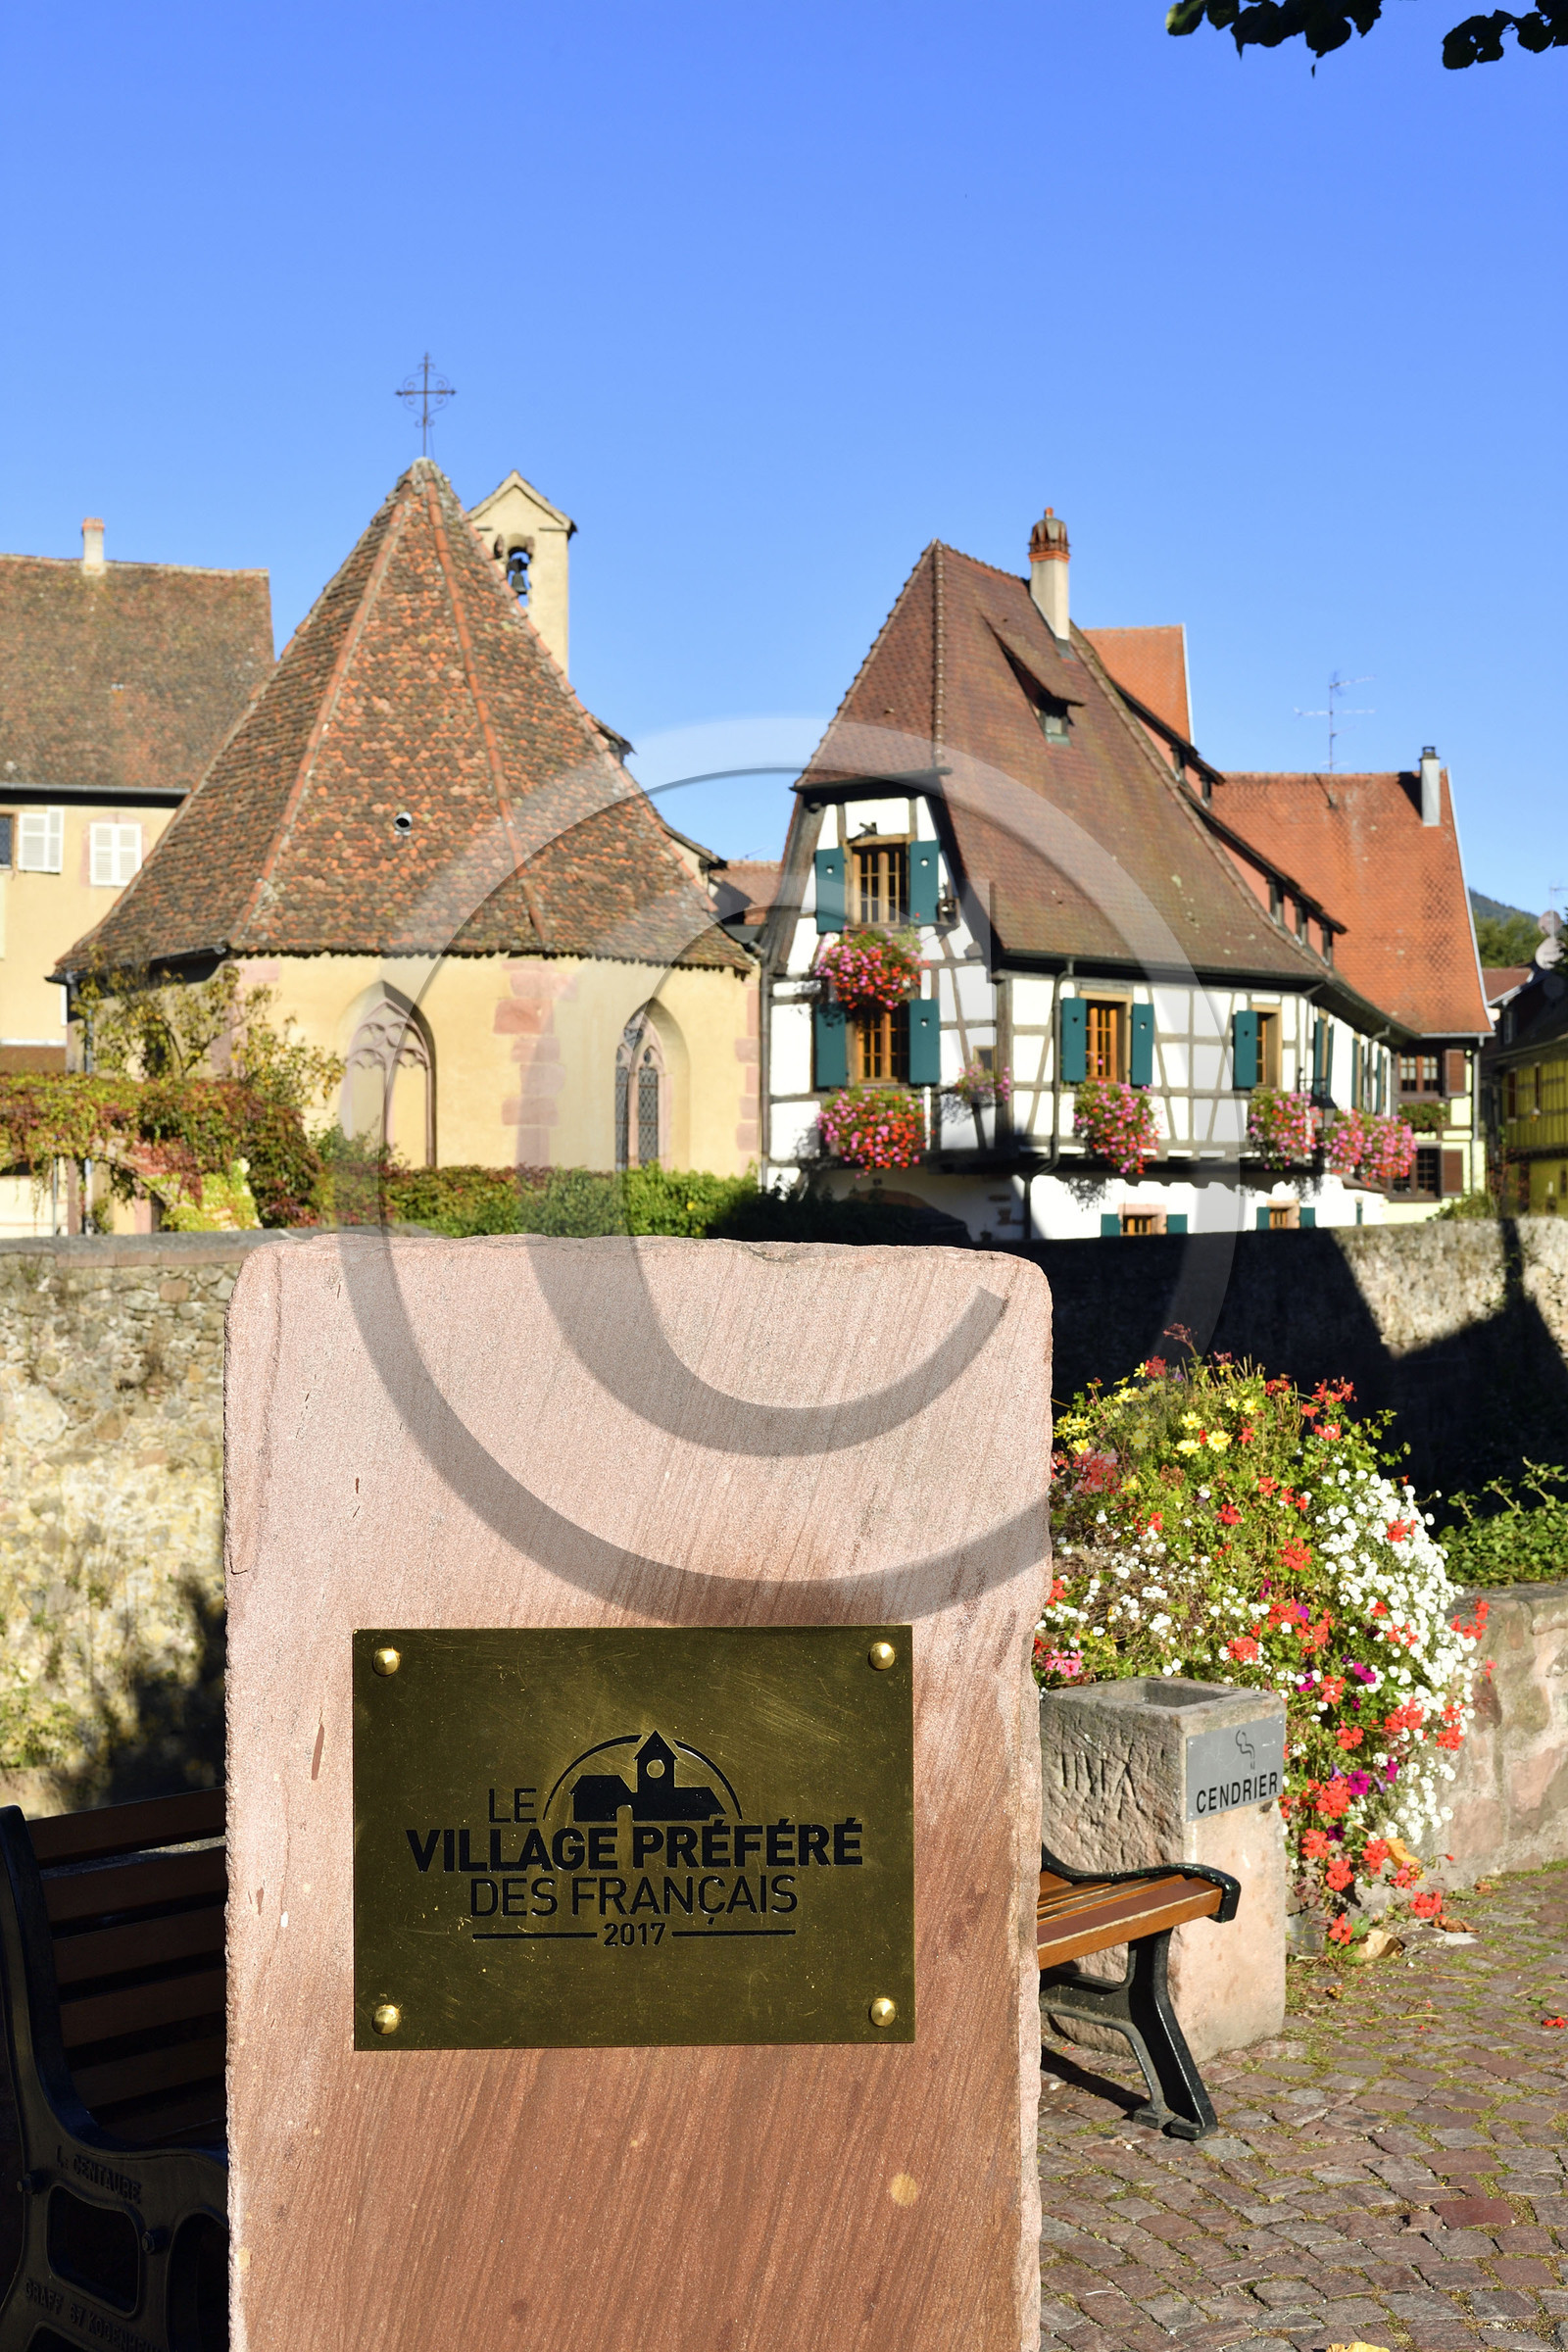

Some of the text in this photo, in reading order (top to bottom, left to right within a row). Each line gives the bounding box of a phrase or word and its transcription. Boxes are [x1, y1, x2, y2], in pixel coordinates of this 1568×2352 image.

[488, 1788, 538, 1824] LE
[1197, 1772, 1278, 1813] CENDRIER
[406, 1817, 863, 1872] VILLAGE PRÉFÉRÉ
[469, 1874, 798, 1926] DES FRANÇAIS
[603, 1922, 666, 1946] 2017
